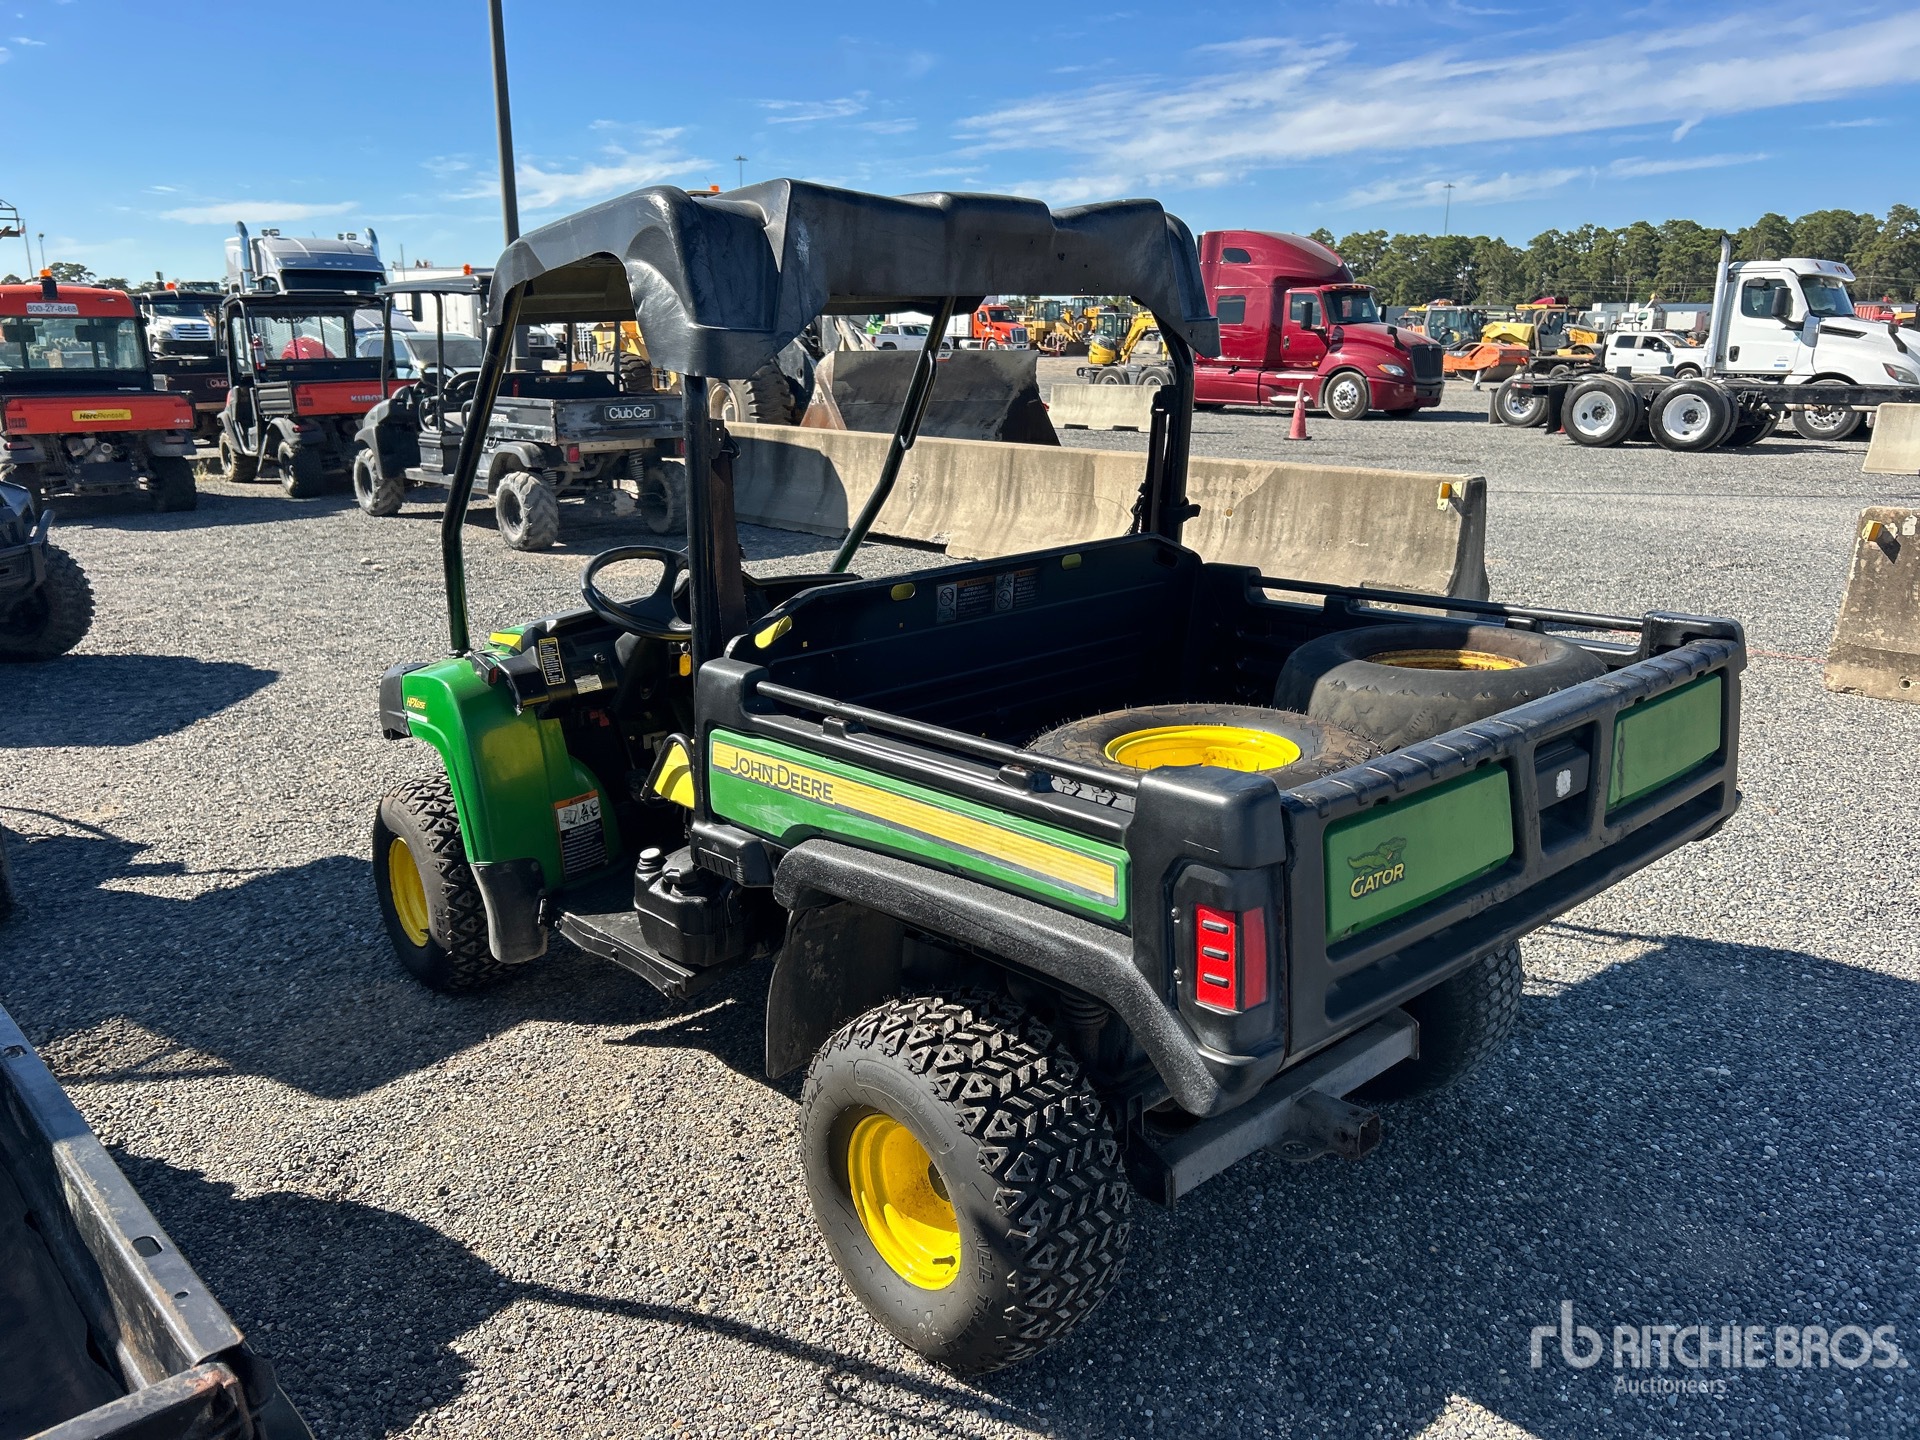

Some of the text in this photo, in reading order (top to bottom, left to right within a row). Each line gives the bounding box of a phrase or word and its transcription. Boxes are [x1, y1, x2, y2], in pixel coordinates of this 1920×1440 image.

[351, 394, 384, 402] KUBOT
[609, 406, 652, 419] Club Car
[730, 752, 834, 802] JOHN DEERE
[1350, 863, 1405, 898] GATOR
